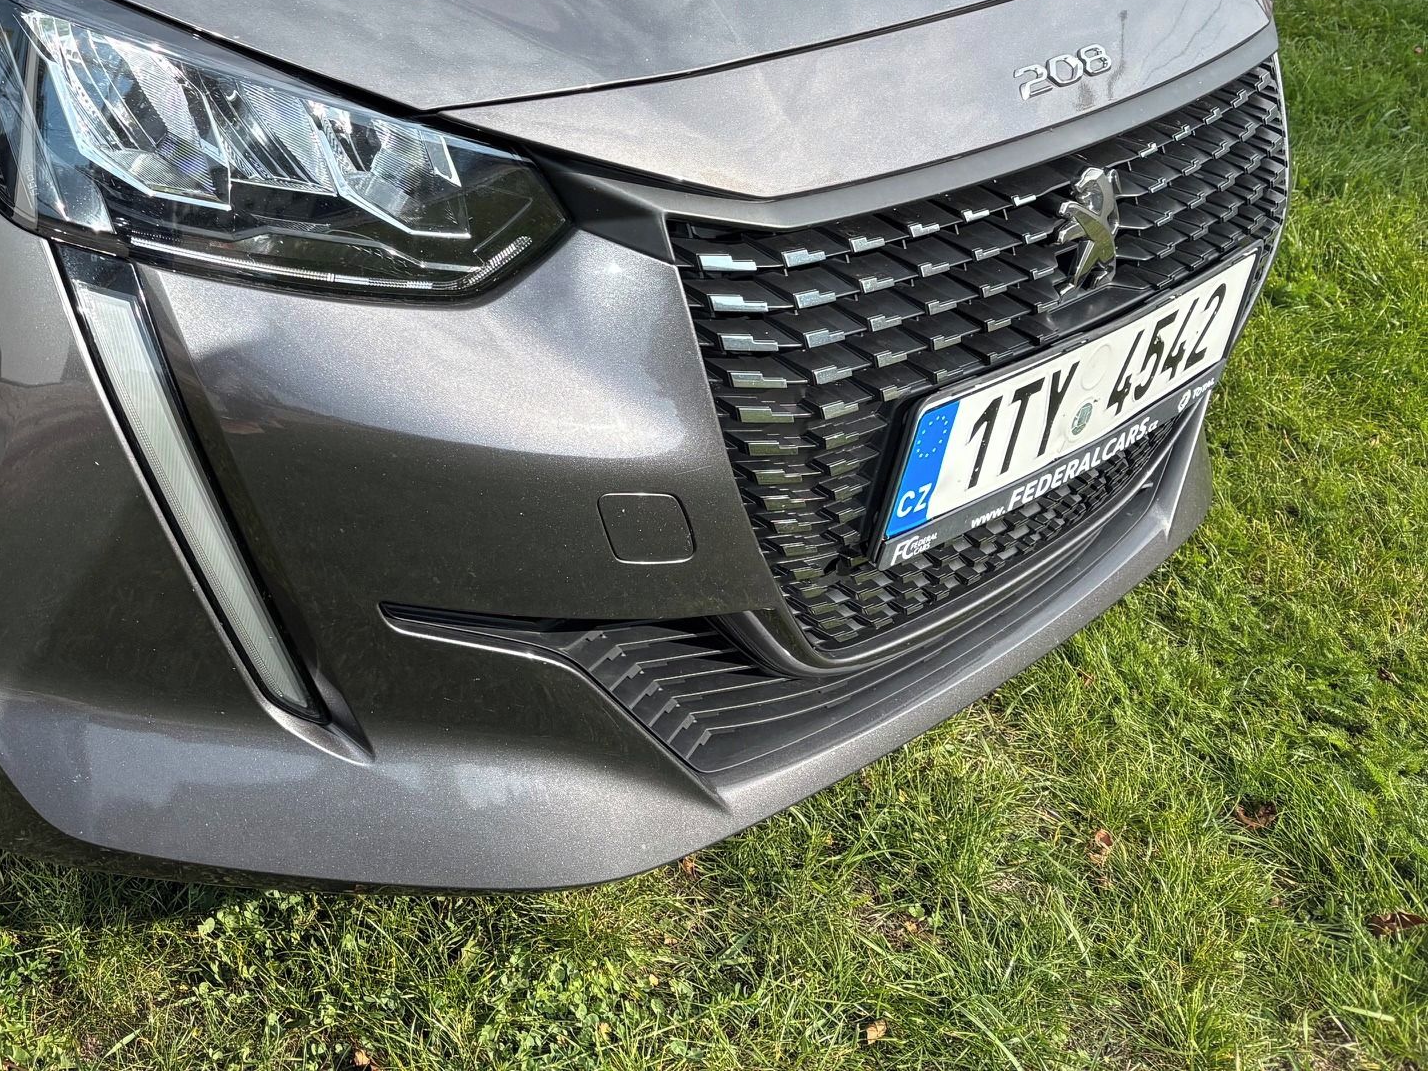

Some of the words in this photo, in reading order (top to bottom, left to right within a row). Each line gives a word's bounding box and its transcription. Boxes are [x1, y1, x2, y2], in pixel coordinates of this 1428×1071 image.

[1013, 43, 1112, 101] 208
[967, 360, 1080, 490] 1TY
[1106, 282, 1227, 416] 4542
[896, 483, 932, 517] CZ
[971, 417, 1159, 528] www.FEDERALCARS.cz
